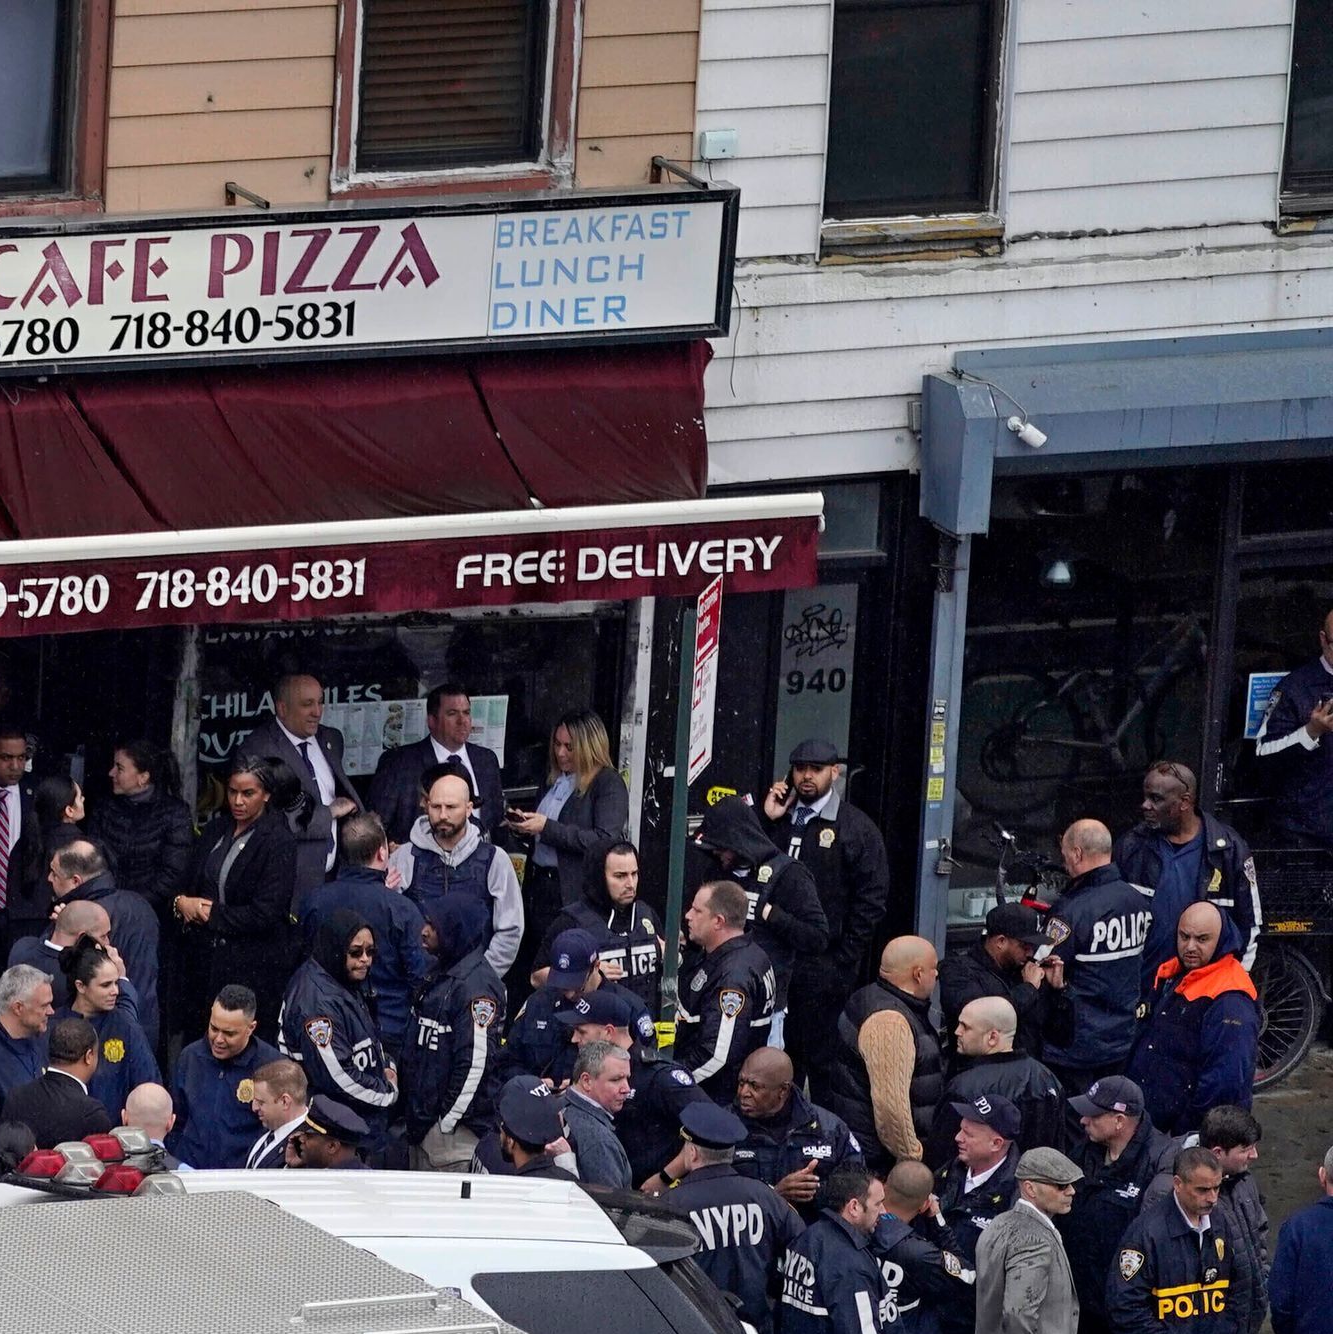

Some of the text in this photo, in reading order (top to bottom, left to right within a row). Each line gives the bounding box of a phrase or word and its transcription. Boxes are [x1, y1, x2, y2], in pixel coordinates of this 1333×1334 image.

[496, 211, 691, 248] BREAKFAST
[208, 222, 442, 298] PIZZA
[494, 253, 645, 290] LUNCH
[108, 300, 358, 352] 718-840-5831
[492, 296, 627, 331] DINER
[136, 557, 367, 611] 718-840-5831
[456, 548, 566, 590] FREE
[578, 535, 783, 582] DELIVERY
[786, 667, 847, 695] 940
[1089, 909, 1154, 954] POLICE
[802, 1145, 832, 1157] POLICE
[690, 1202, 765, 1252] NYPD
